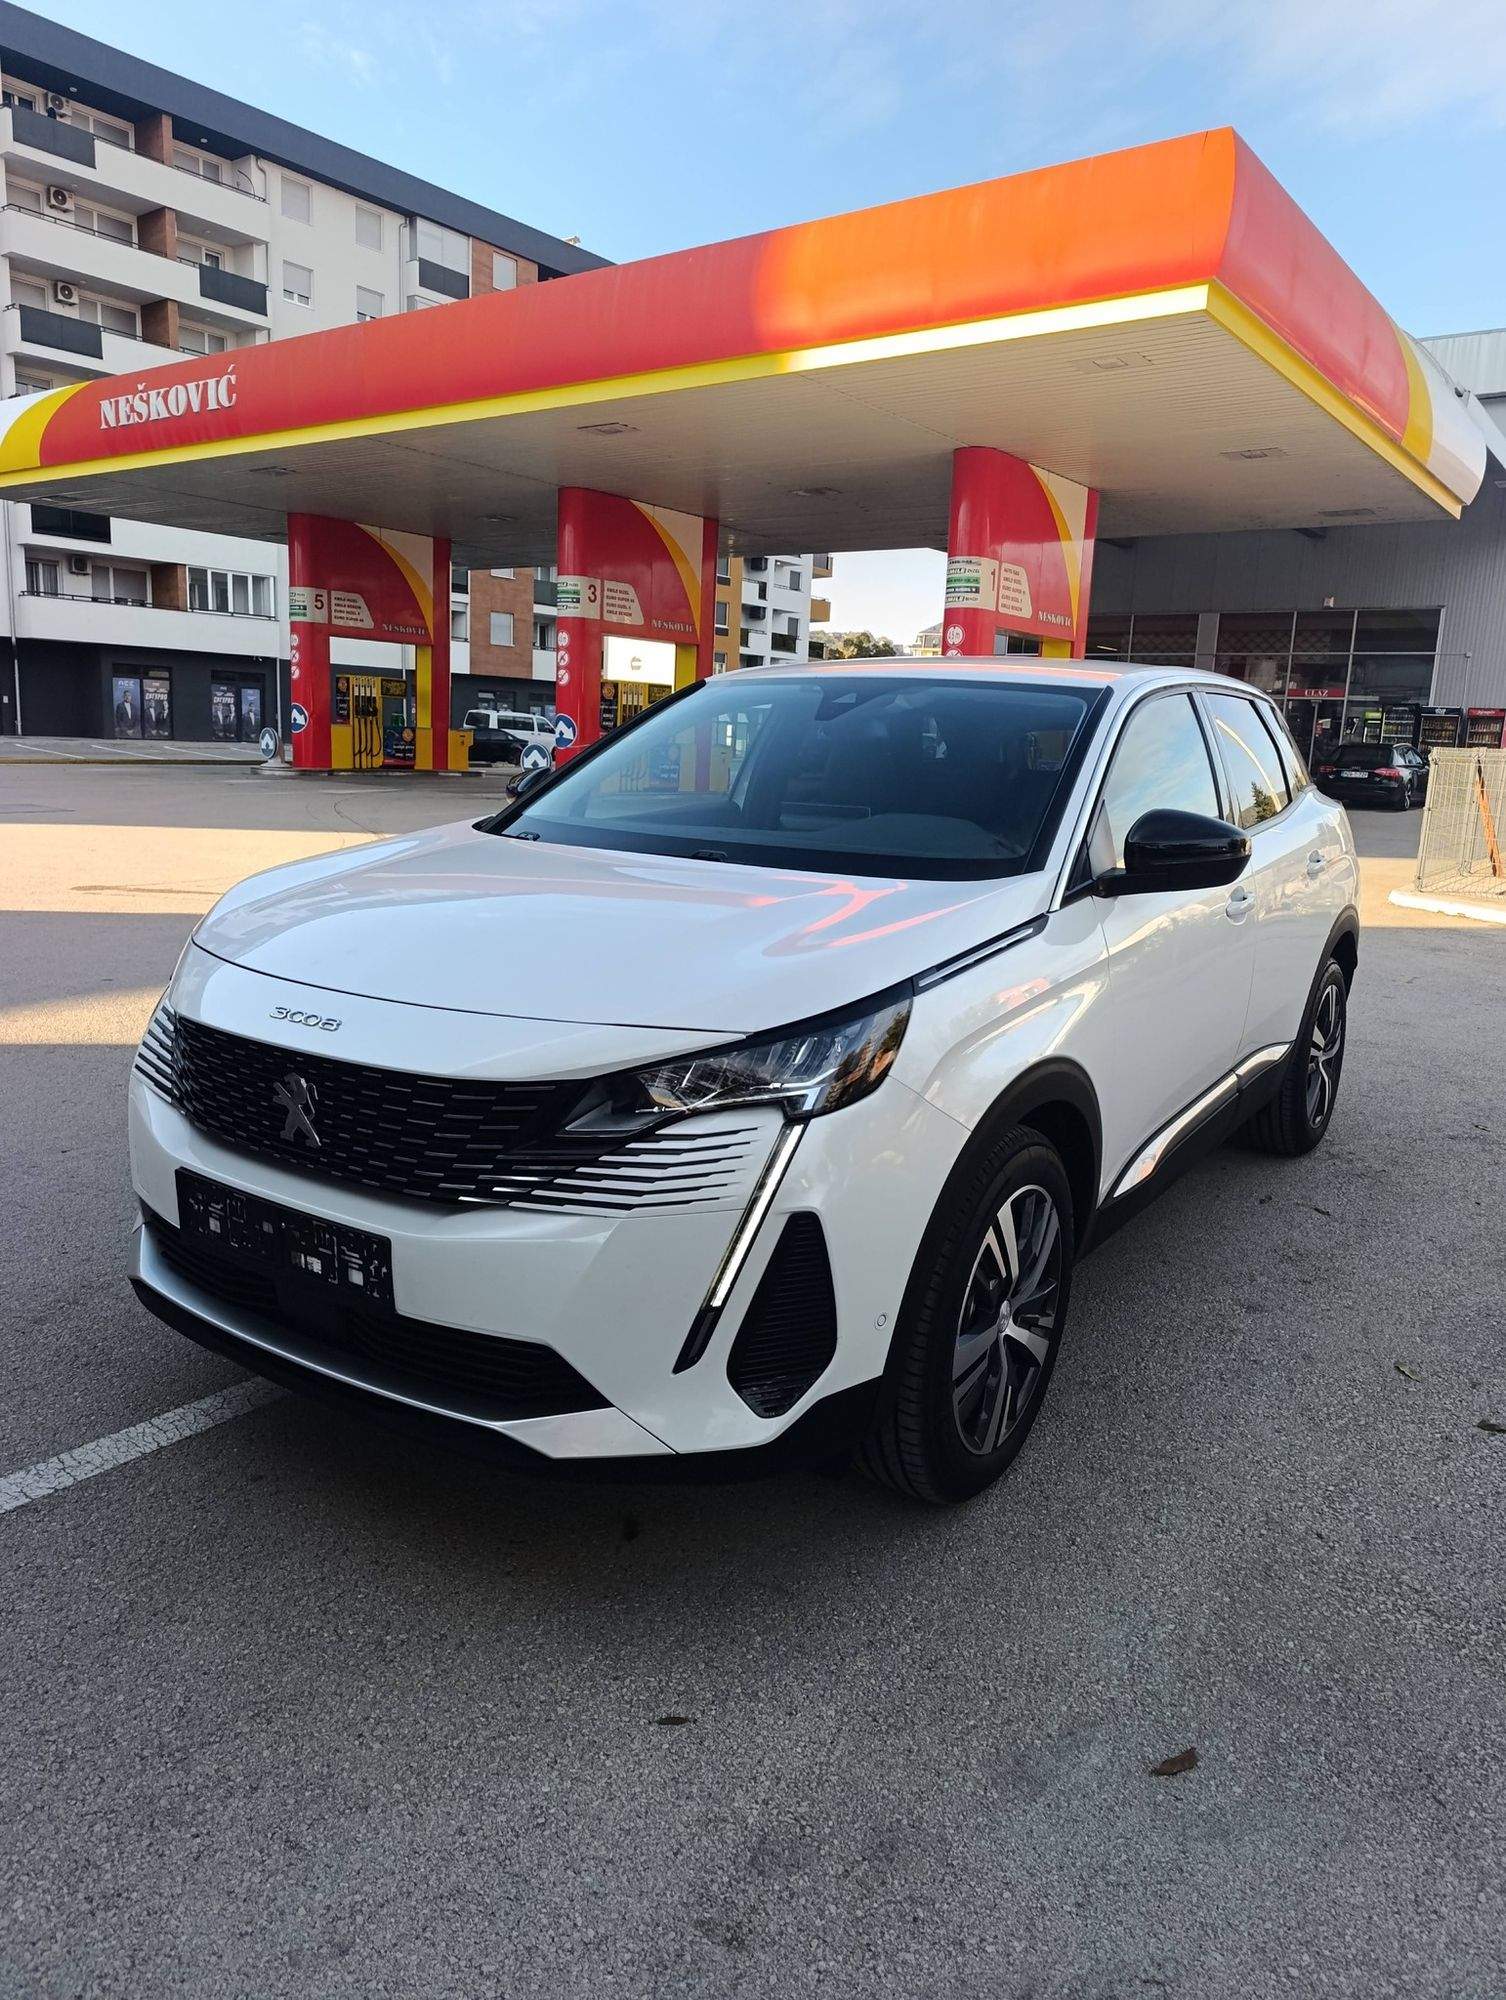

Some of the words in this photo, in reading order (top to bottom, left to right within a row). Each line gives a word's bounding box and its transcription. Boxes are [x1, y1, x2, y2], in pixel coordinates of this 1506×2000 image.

[100, 364, 237, 429] NEŠKOVIĆ
[990, 568, 996, 592] 1
[314, 593, 325, 610] 5
[587, 584, 598, 603] 3
[269, 1006, 342, 1032] 3008
